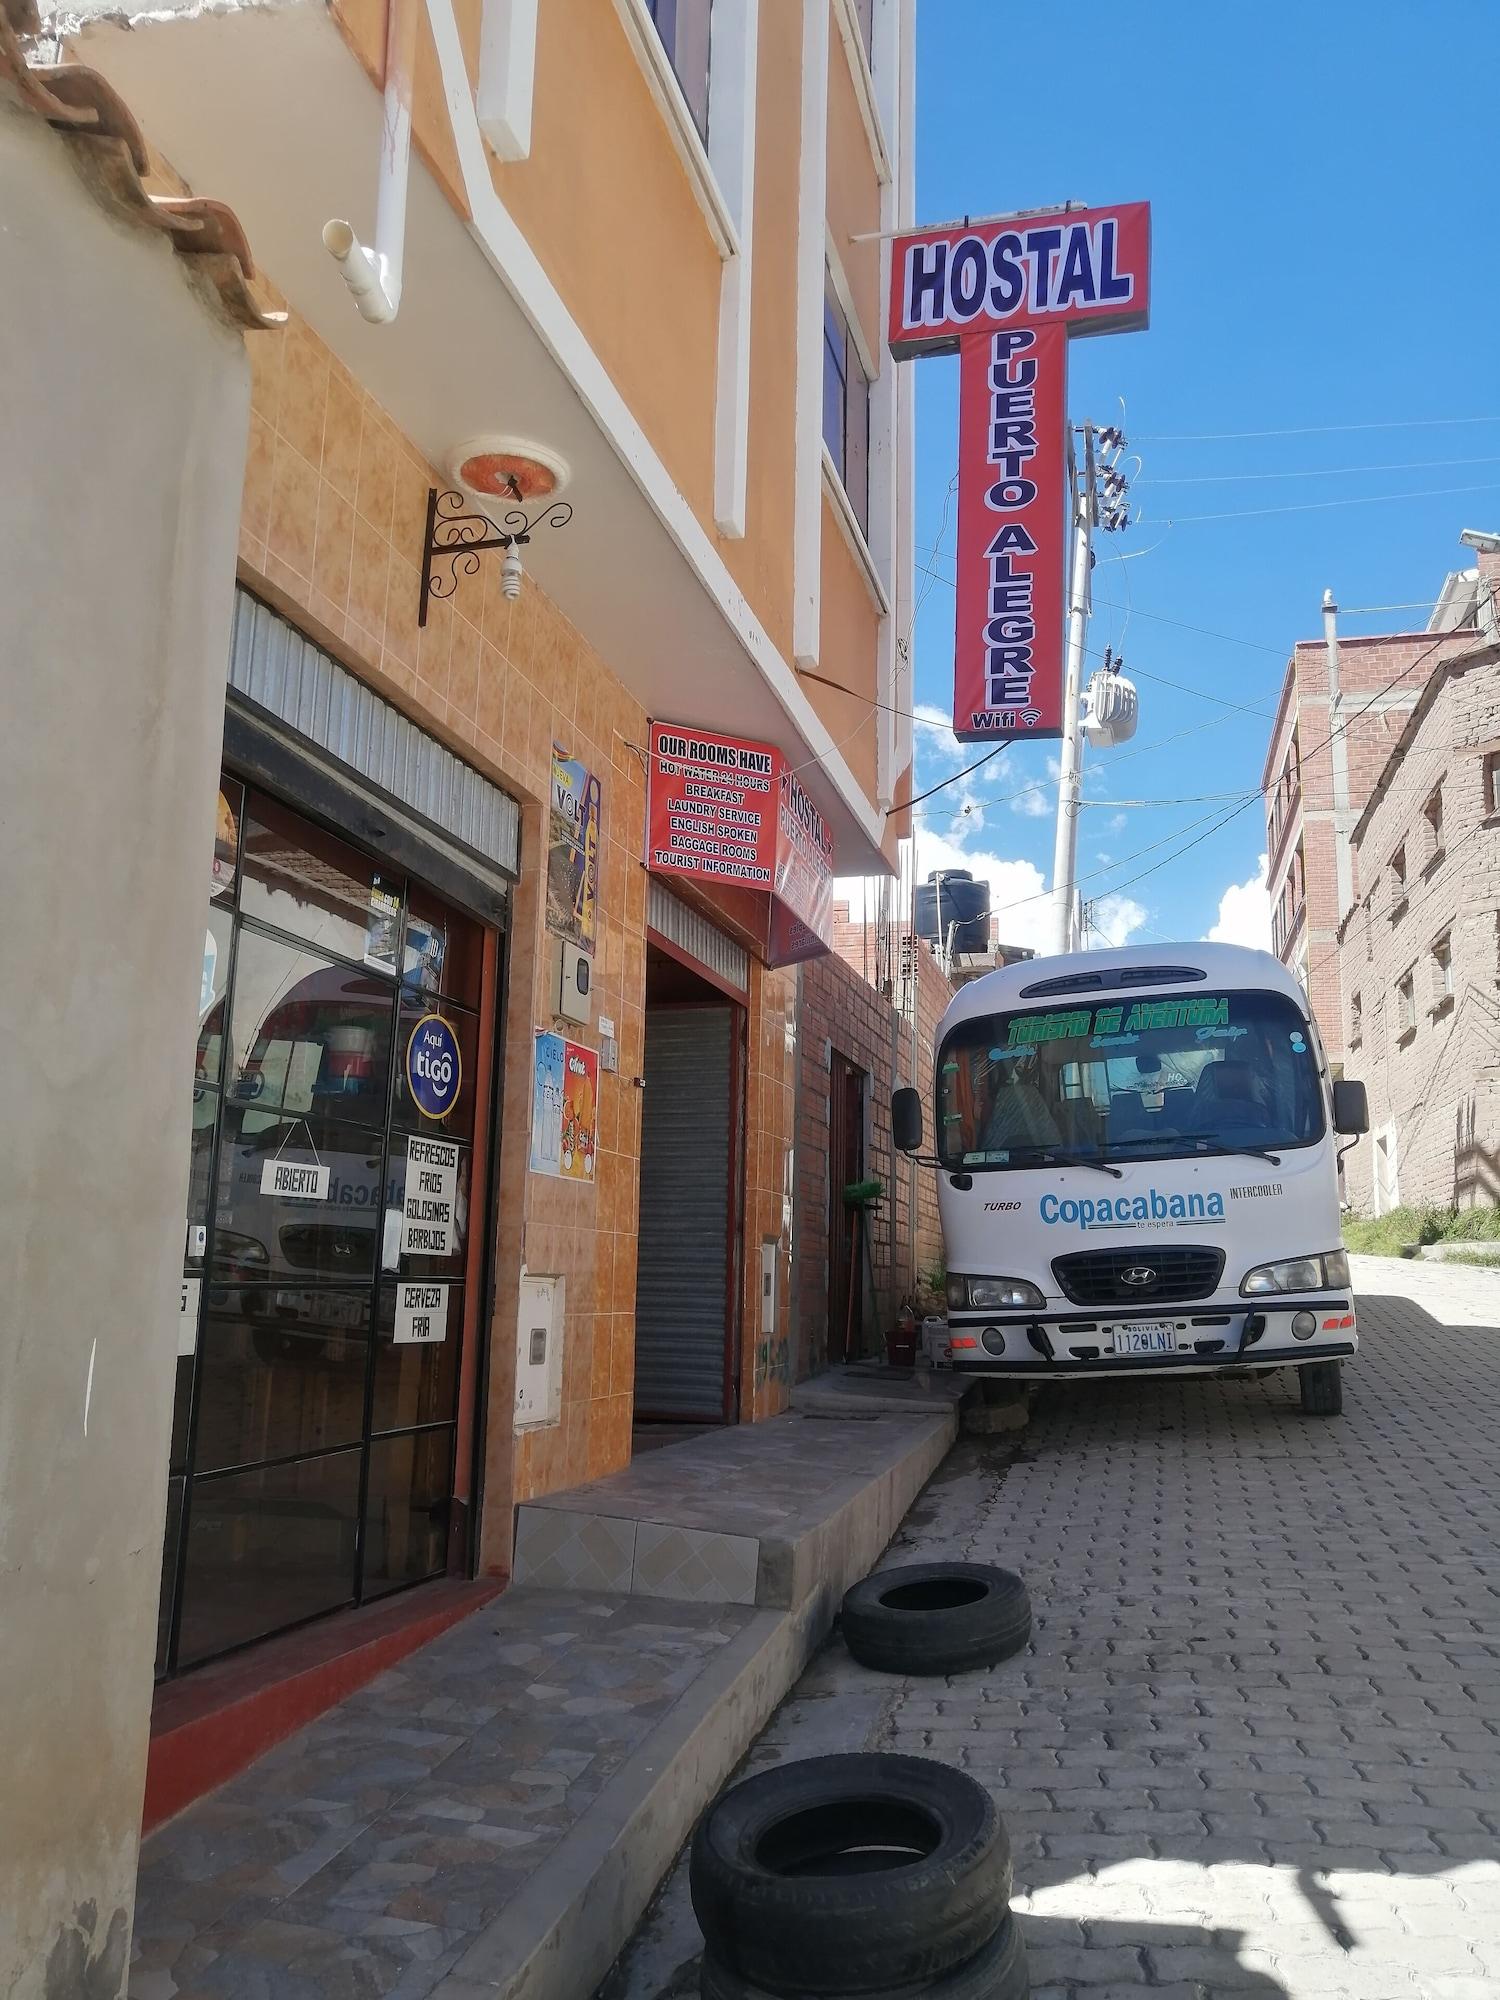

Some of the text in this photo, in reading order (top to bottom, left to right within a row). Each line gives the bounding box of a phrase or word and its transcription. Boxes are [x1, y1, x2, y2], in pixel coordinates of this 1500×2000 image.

[907, 221, 1132, 325] HOSTAL
[985, 331, 1037, 707] PUERTO ALEGRE
[972, 710, 1016, 729] Wifi
[659, 736, 771, 773] OUR ROOMS HAVE
[660, 762, 770, 791] HOT WATER 24 HOURS
[557, 784, 586, 826] VOLT
[686, 784, 744, 804] BREAKFAST
[668, 800, 760, 825] LAUNDRY SERVICE
[789, 773, 827, 850] HOSTAL
[670, 818, 758, 843] ENGLISH SPOKEN
[671, 836, 757, 860] BAGGAGE ROOMS
[655, 851, 699, 870] TOURIST
[701, 861, 770, 880] INFORMATION
[1008, 1011, 1092, 1046] TURISMO
[1093, 1006, 1123, 1034] DE
[1124, 998, 1229, 1032] AVENTURA
[424, 1030, 443, 1049] Aquí
[546, 1047, 563, 1063] CIELO
[409, 1140, 456, 1168] REFRESCOS
[275, 1167, 319, 1194] ABIERTO
[1230, 1184, 1283, 1200] INTERCOOLER
[406, 1198, 450, 1223] GOLOSINAS
[983, 1202, 1021, 1211] TURBO
[1040, 1189, 1225, 1230] Copacabana
[1137, 1220, 1174, 1230] te espera
[407, 1227, 446, 1251] BARBIJOS
[404, 1288, 441, 1308] CERVEZA
